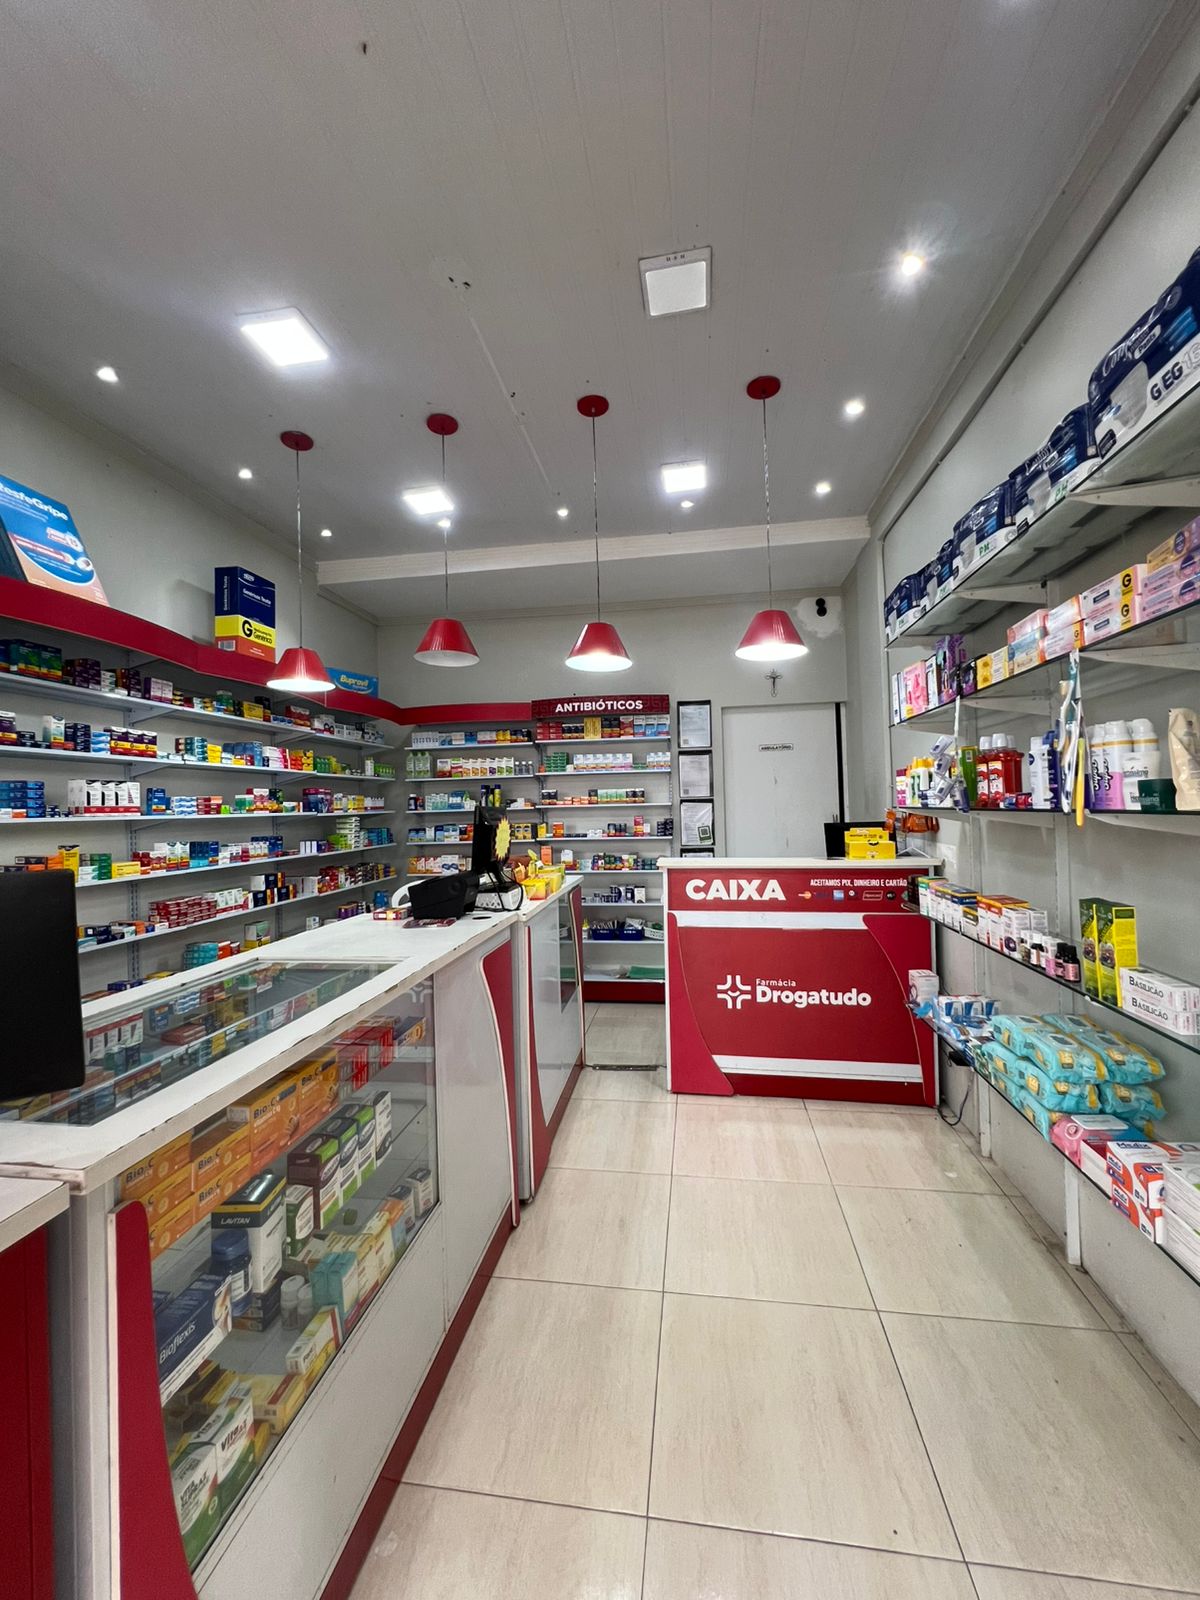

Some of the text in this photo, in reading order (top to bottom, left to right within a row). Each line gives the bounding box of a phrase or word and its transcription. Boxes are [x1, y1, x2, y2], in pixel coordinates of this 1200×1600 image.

[1162, 361, 1183, 390] EG
[1122, 573, 1132, 588] G
[1121, 604, 1130, 617] G
[242, 619, 253, 638] G
[555, 699, 644, 713] ANTIBIÓTICOS
[810, 879, 841, 887] ACEITAMOS
[842, 879, 852, 887] PIX,
[853, 879, 880, 887] DINHEIRO
[885, 877, 908, 887] CARTÃO
[685, 879, 786, 901] CAIXA
[755, 977, 796, 987] Farmácia
[755, 988, 872, 1008] Drogatudo
[220, 1217, 251, 1225] LAVITAN
[159, 1321, 197, 1365] Bioflexis
